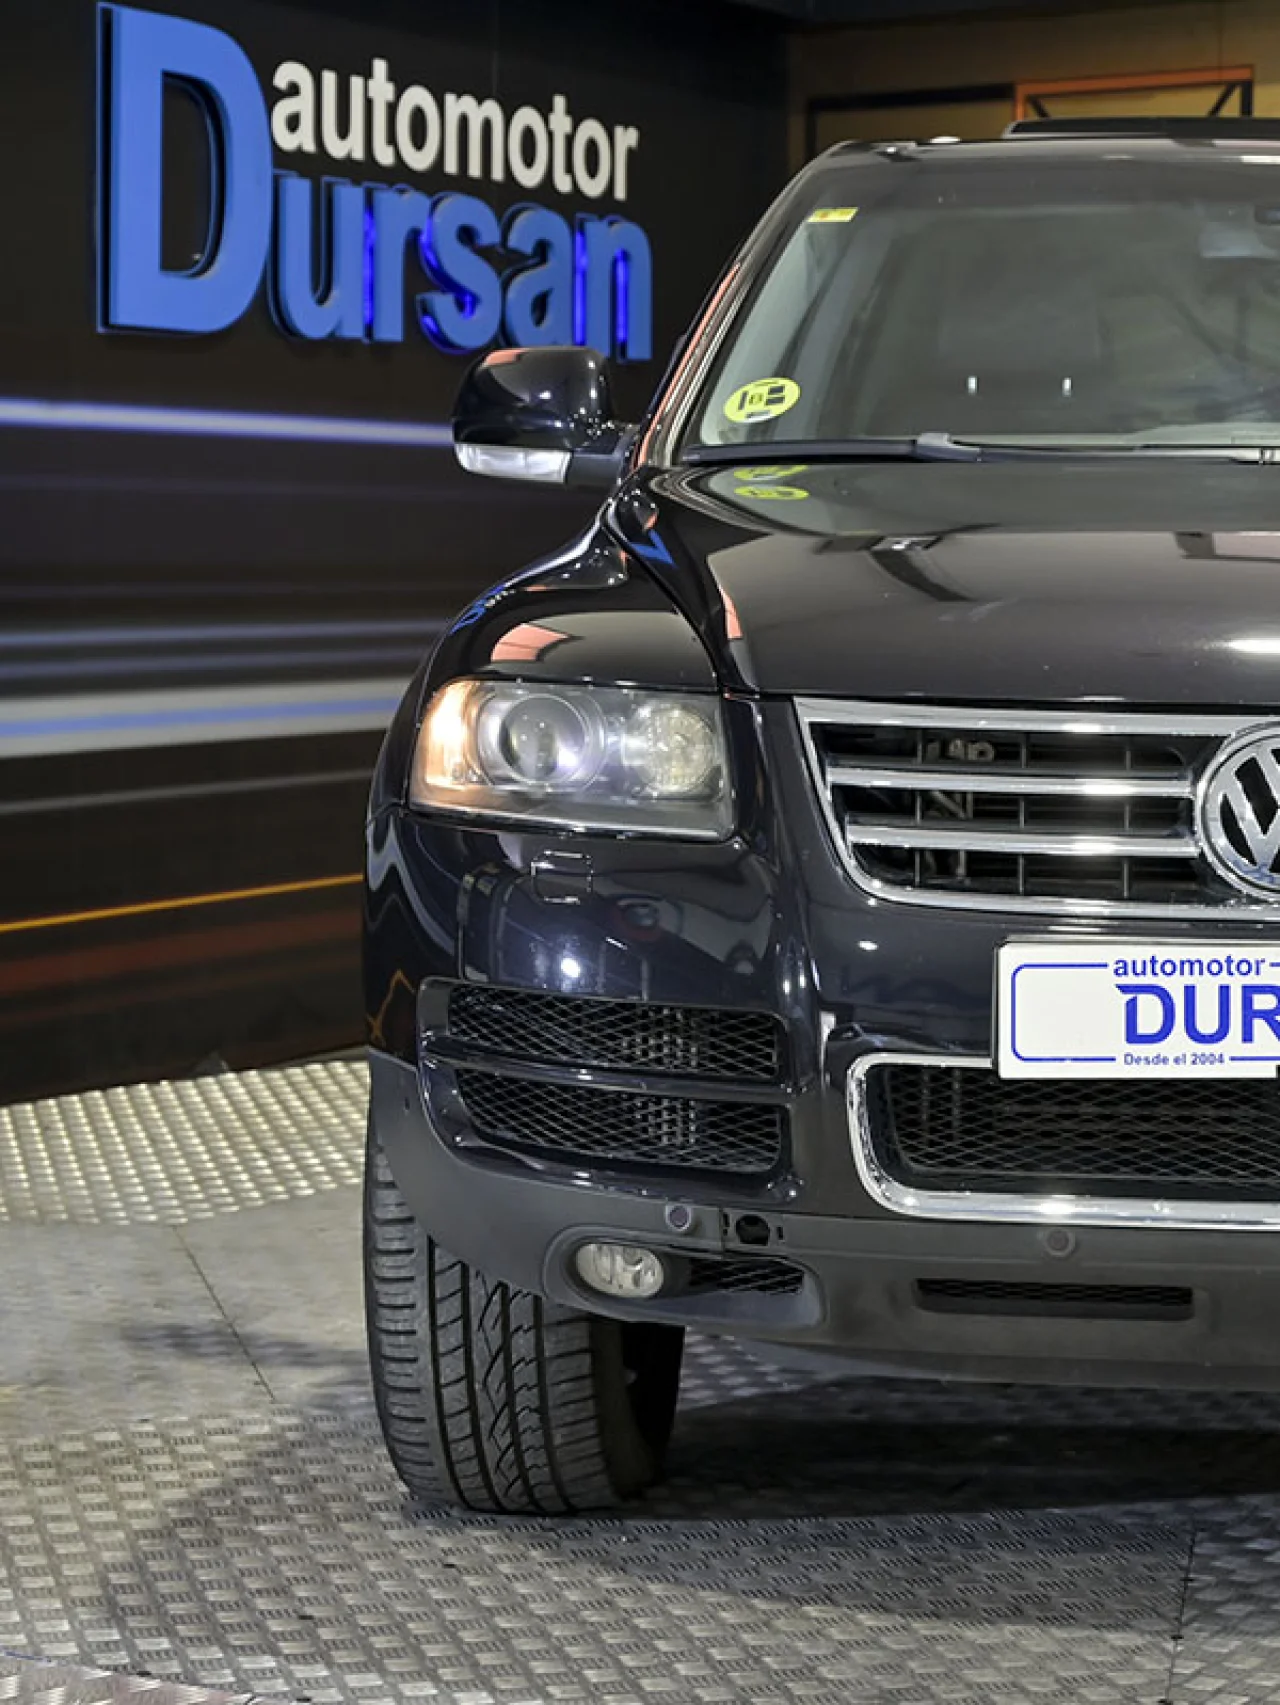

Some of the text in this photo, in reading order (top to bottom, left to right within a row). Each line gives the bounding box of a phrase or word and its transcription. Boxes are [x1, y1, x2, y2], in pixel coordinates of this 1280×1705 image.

[271, 57, 639, 201] automotor
[96, 2, 652, 362] Dursan
[1113, 955, 1265, 976] automotor
[1123, 1053, 1225, 1065] Desde el 2004
